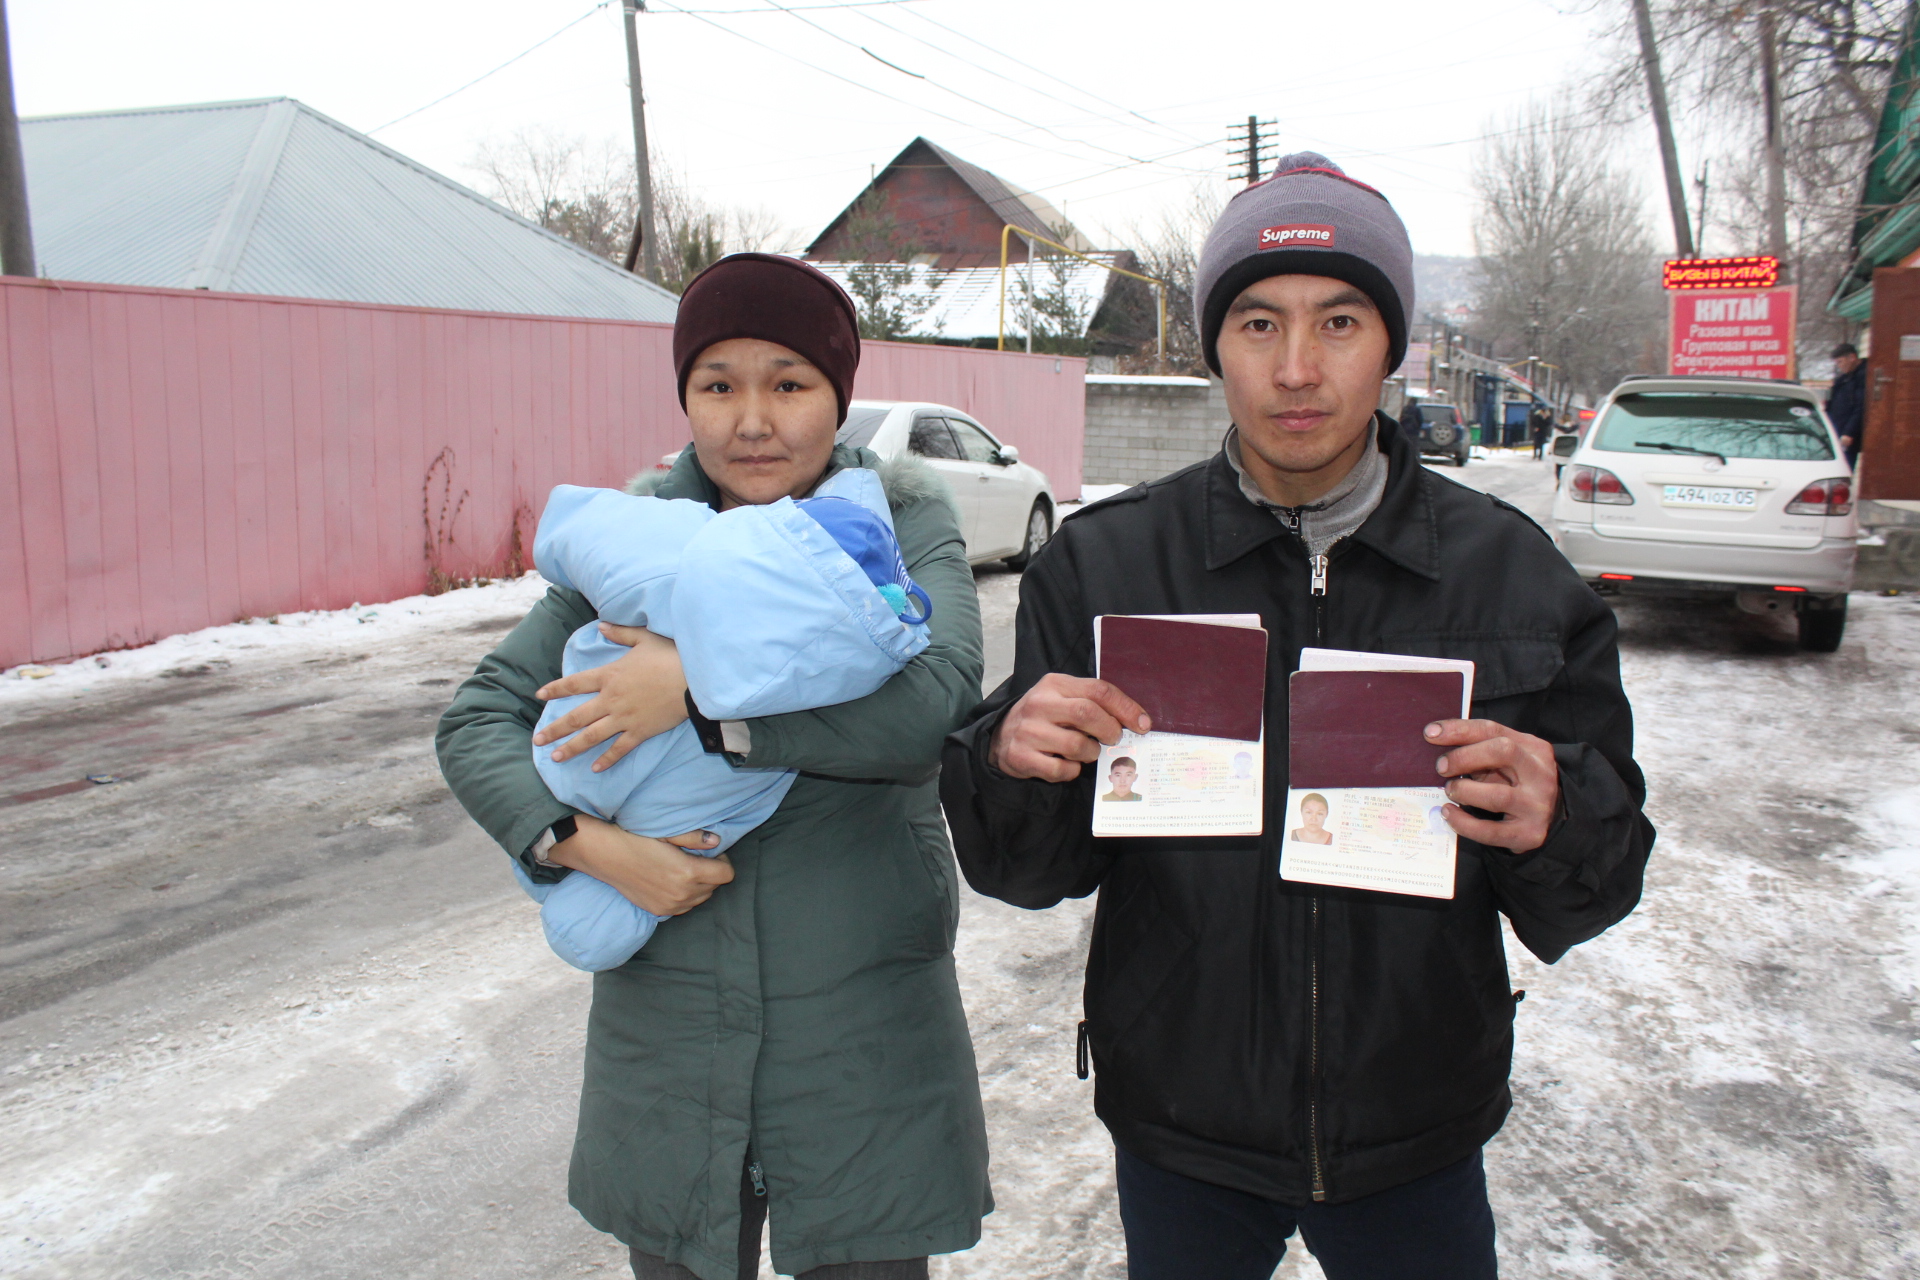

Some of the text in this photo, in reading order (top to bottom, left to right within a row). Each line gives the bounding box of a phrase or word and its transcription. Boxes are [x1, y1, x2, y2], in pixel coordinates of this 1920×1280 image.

[1262, 228, 1330, 244] Supreme
[1670, 262, 1772, 281] ВИЗЫ В КИТАЙ
[1694, 293, 1770, 322] КИТАЙ
[1690, 324, 1772, 338] Разовая виза
[1682, 339, 1780, 355] Групповая виза
[1675, 354, 1786, 369] Электронная виза
[1735, 490, 1754, 504] 05
